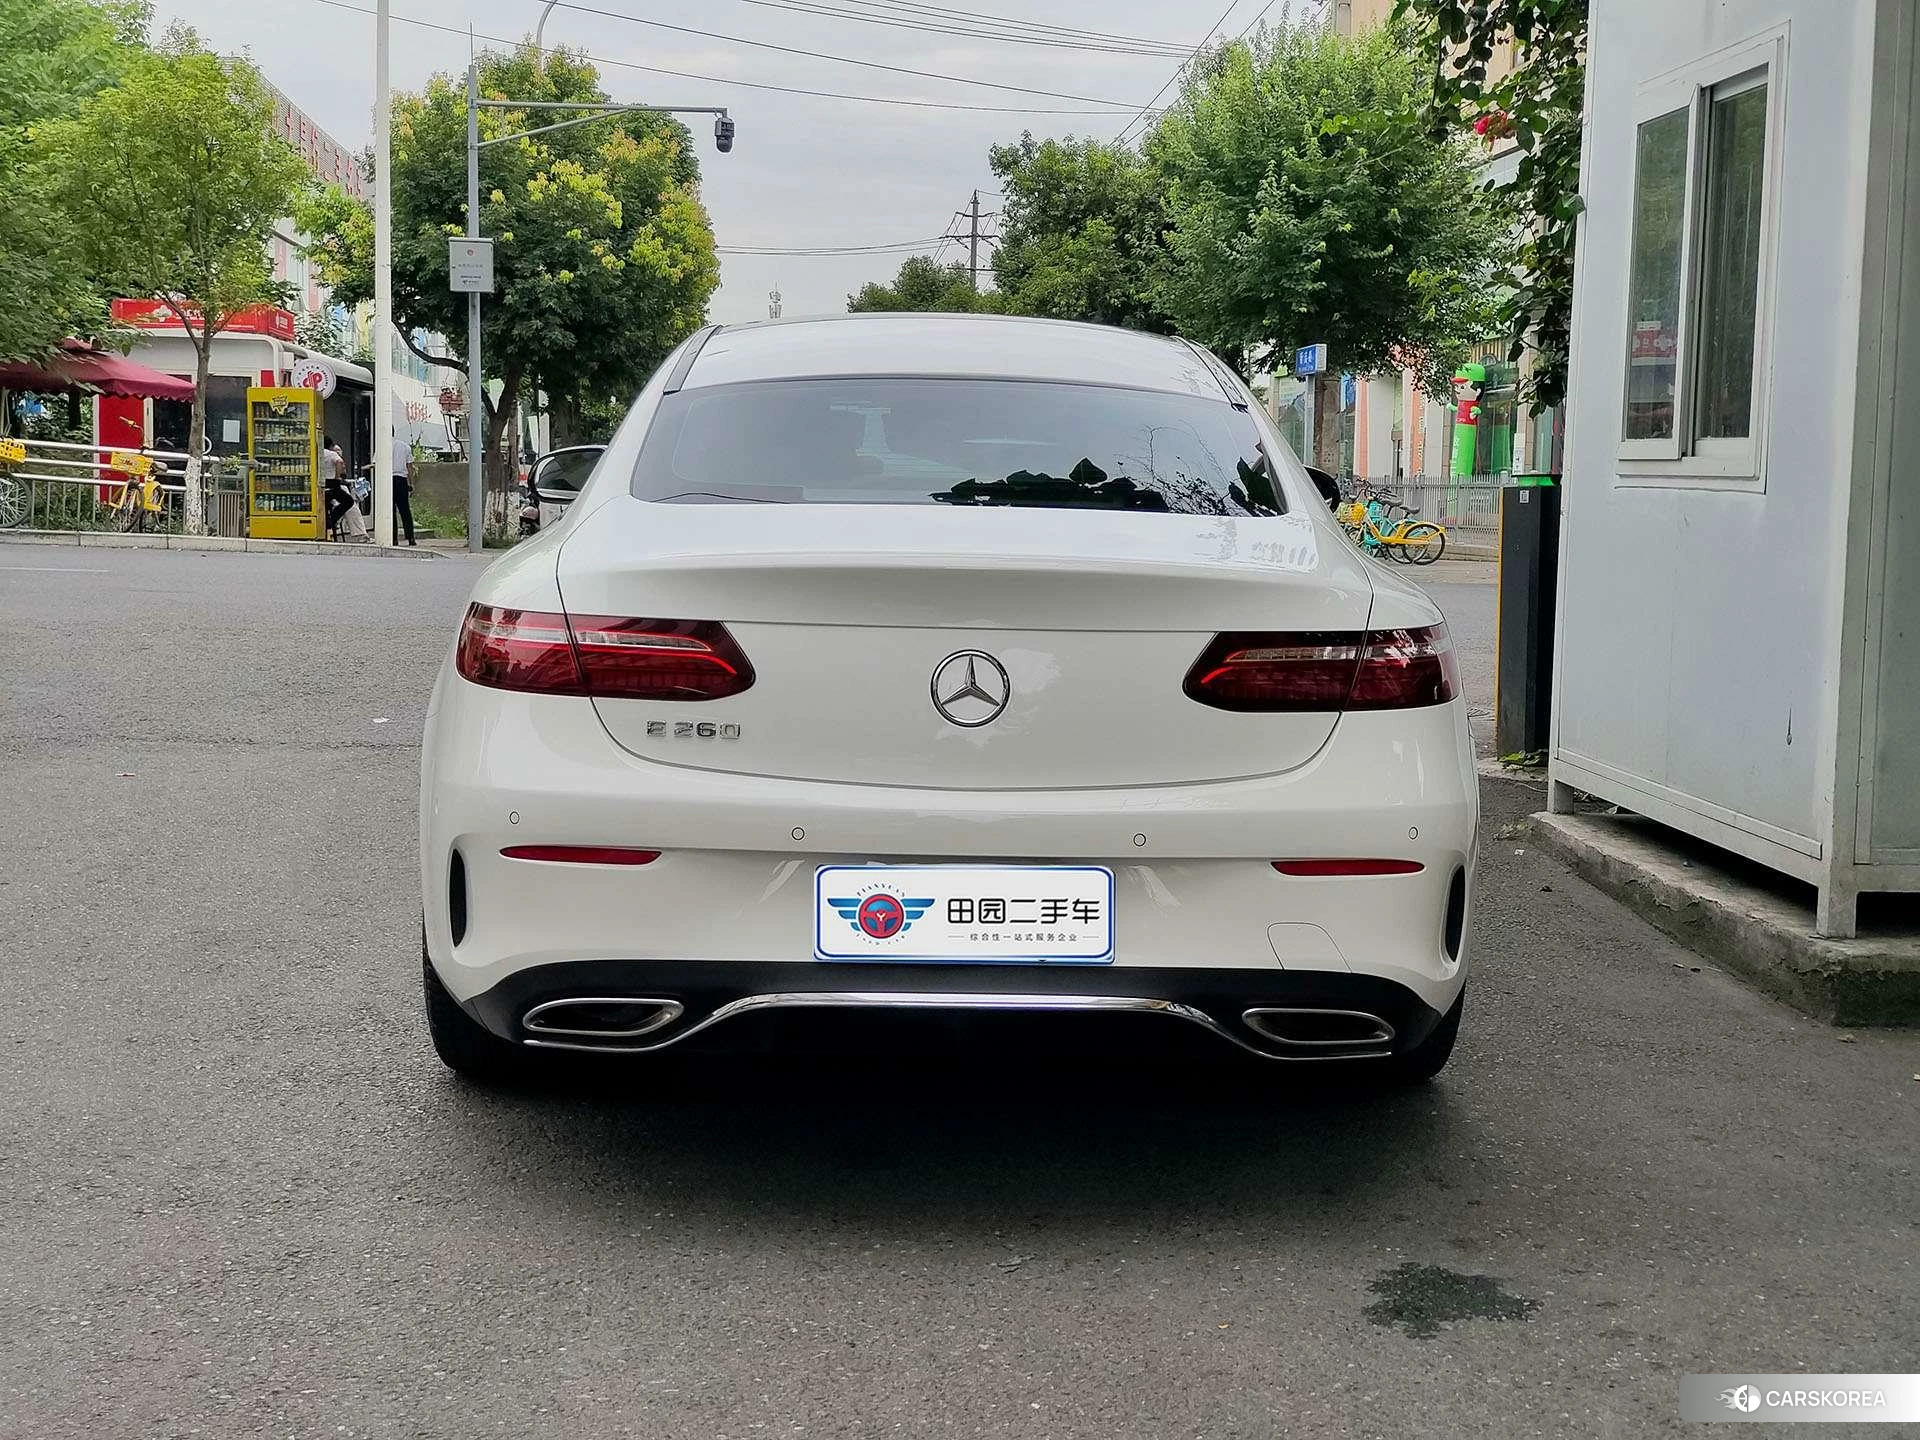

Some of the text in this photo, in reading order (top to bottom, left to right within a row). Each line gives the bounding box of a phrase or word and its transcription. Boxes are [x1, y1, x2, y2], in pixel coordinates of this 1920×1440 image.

[647, 720, 741, 739] E 260
[947, 898, 1100, 925] 田园二手车
[970, 932, 1078, 942] 综合性一站式服务企业
